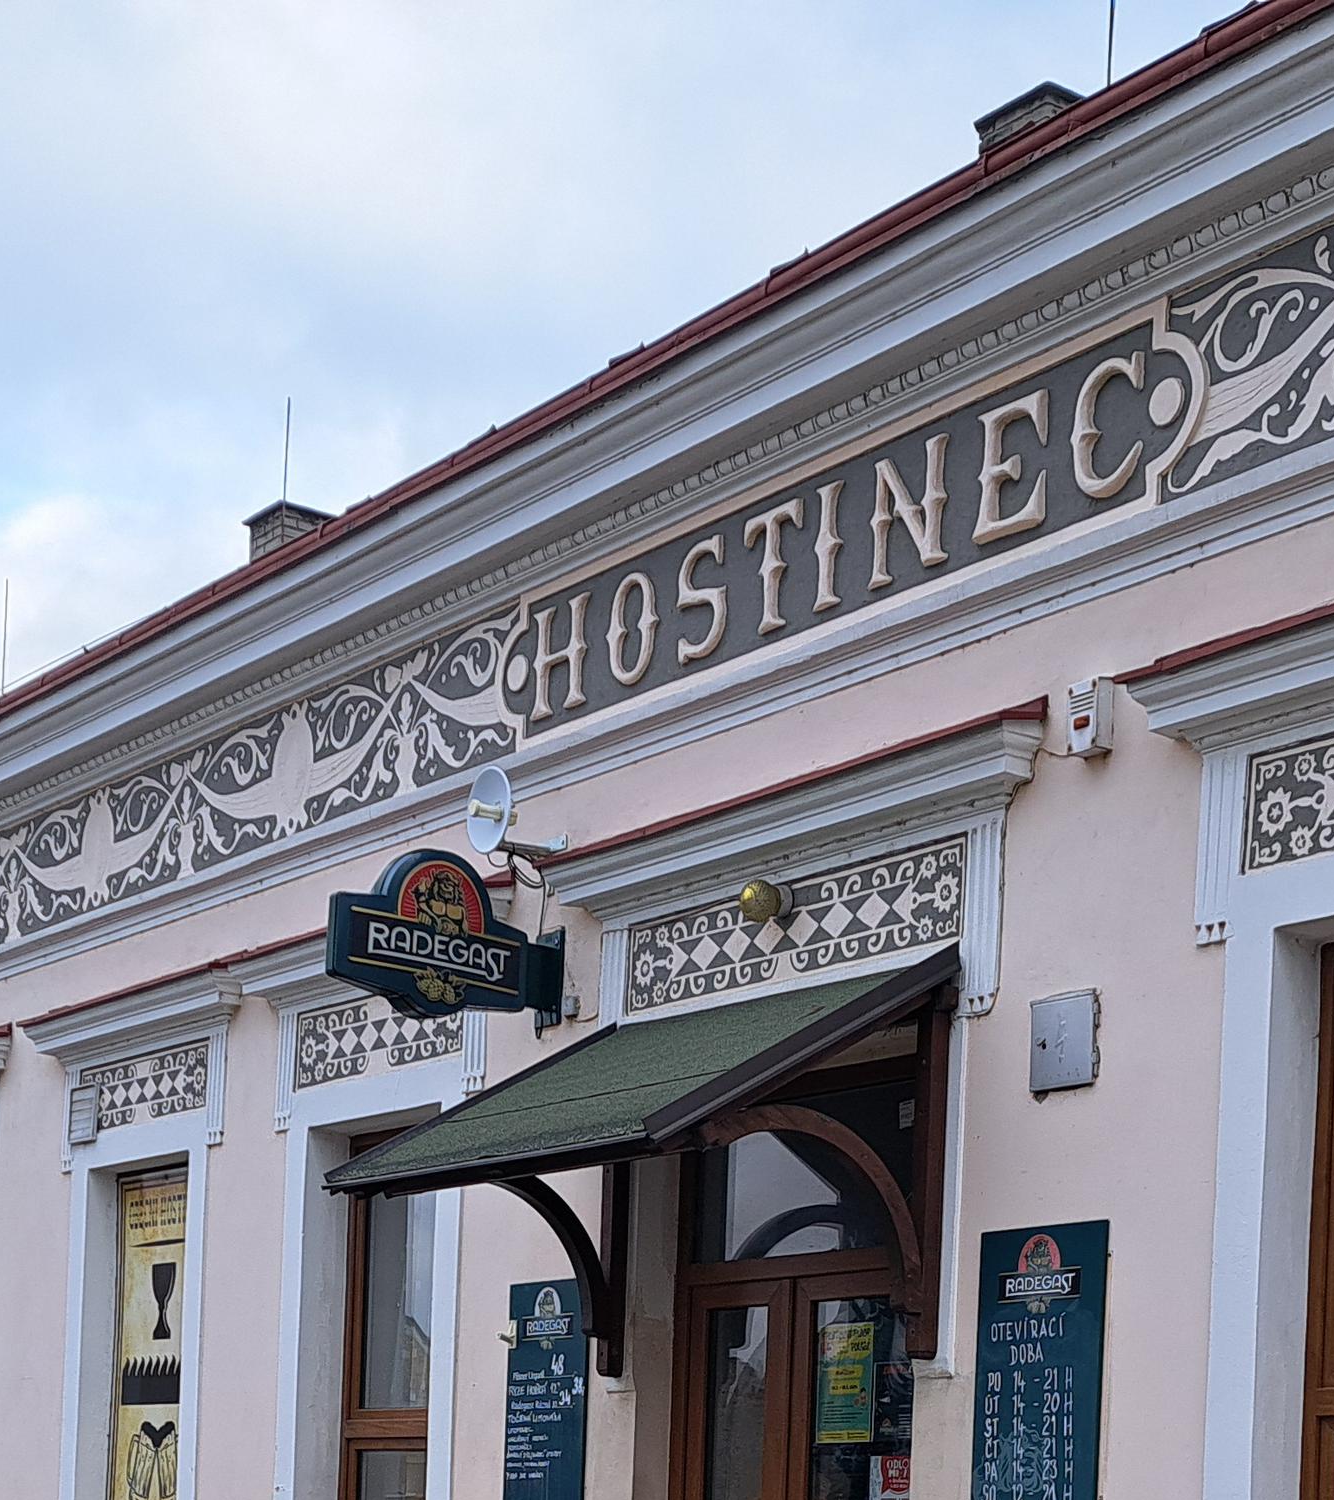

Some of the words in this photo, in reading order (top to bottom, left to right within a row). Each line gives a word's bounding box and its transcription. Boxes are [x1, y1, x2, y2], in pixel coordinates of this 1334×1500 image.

[530, 350, 1146, 721] HOSTINEC
[367, 920, 511, 982] RADEGAST
[1005, 1272, 1076, 1298] RADEGAST
[526, 1318, 571, 1336] RADEGAST
[990, 1311, 1067, 1343] OTEVÍRACÍ
[1008, 1340, 1044, 1366] DOBA
[987, 1371, 1002, 1392] PO
[1013, 1370, 1026, 1393] 14
[1043, 1367, 1058, 1390] 21
[1065, 1366, 1073, 1390] H
[984, 1394, 1000, 1415] ÚT
[1012, 1394, 1026, 1416] 14
[1042, 1392, 1061, 1413] 20
[1063, 1391, 1073, 1414] H
[1012, 1416, 1026, 1437] 14
[1041, 1415, 1057, 1436] 21
[1063, 1415, 1073, 1437] H
[984, 1437, 1000, 1459] ČT
[1012, 1439, 1025, 1460] 14
[1042, 1437, 1057, 1458] 21
[1064, 1437, 1073, 1459] H
[1012, 1461, 1024, 1481] 14
[1042, 1460, 1058, 1481] 23
[1064, 1460, 1073, 1483] H
